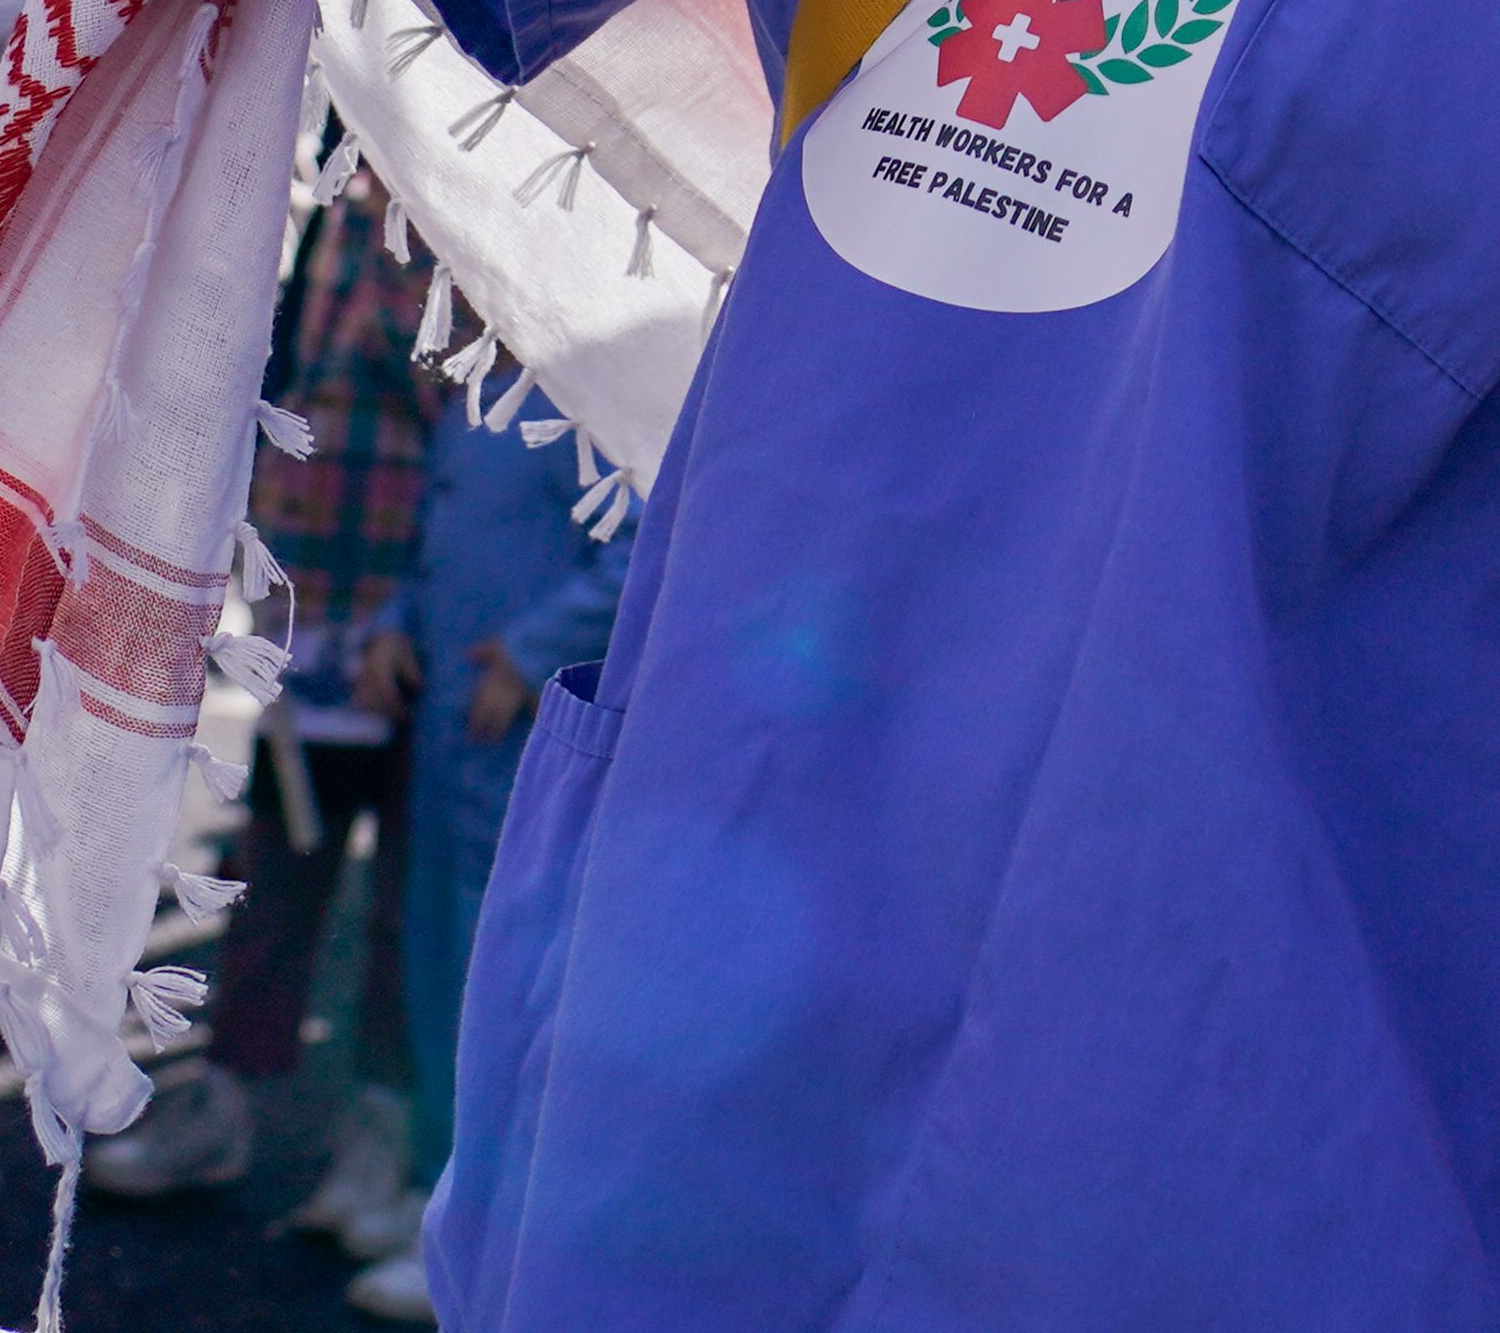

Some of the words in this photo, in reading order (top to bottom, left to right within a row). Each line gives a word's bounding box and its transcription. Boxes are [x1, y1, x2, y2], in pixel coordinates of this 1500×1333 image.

[861, 107, 936, 143] HEALTH
[935, 123, 1053, 185] WORKERS
[1054, 168, 1110, 208] FOR
[1112, 192, 1133, 218] A
[872, 156, 928, 190] FREE
[927, 171, 1070, 244] PALESTINE
